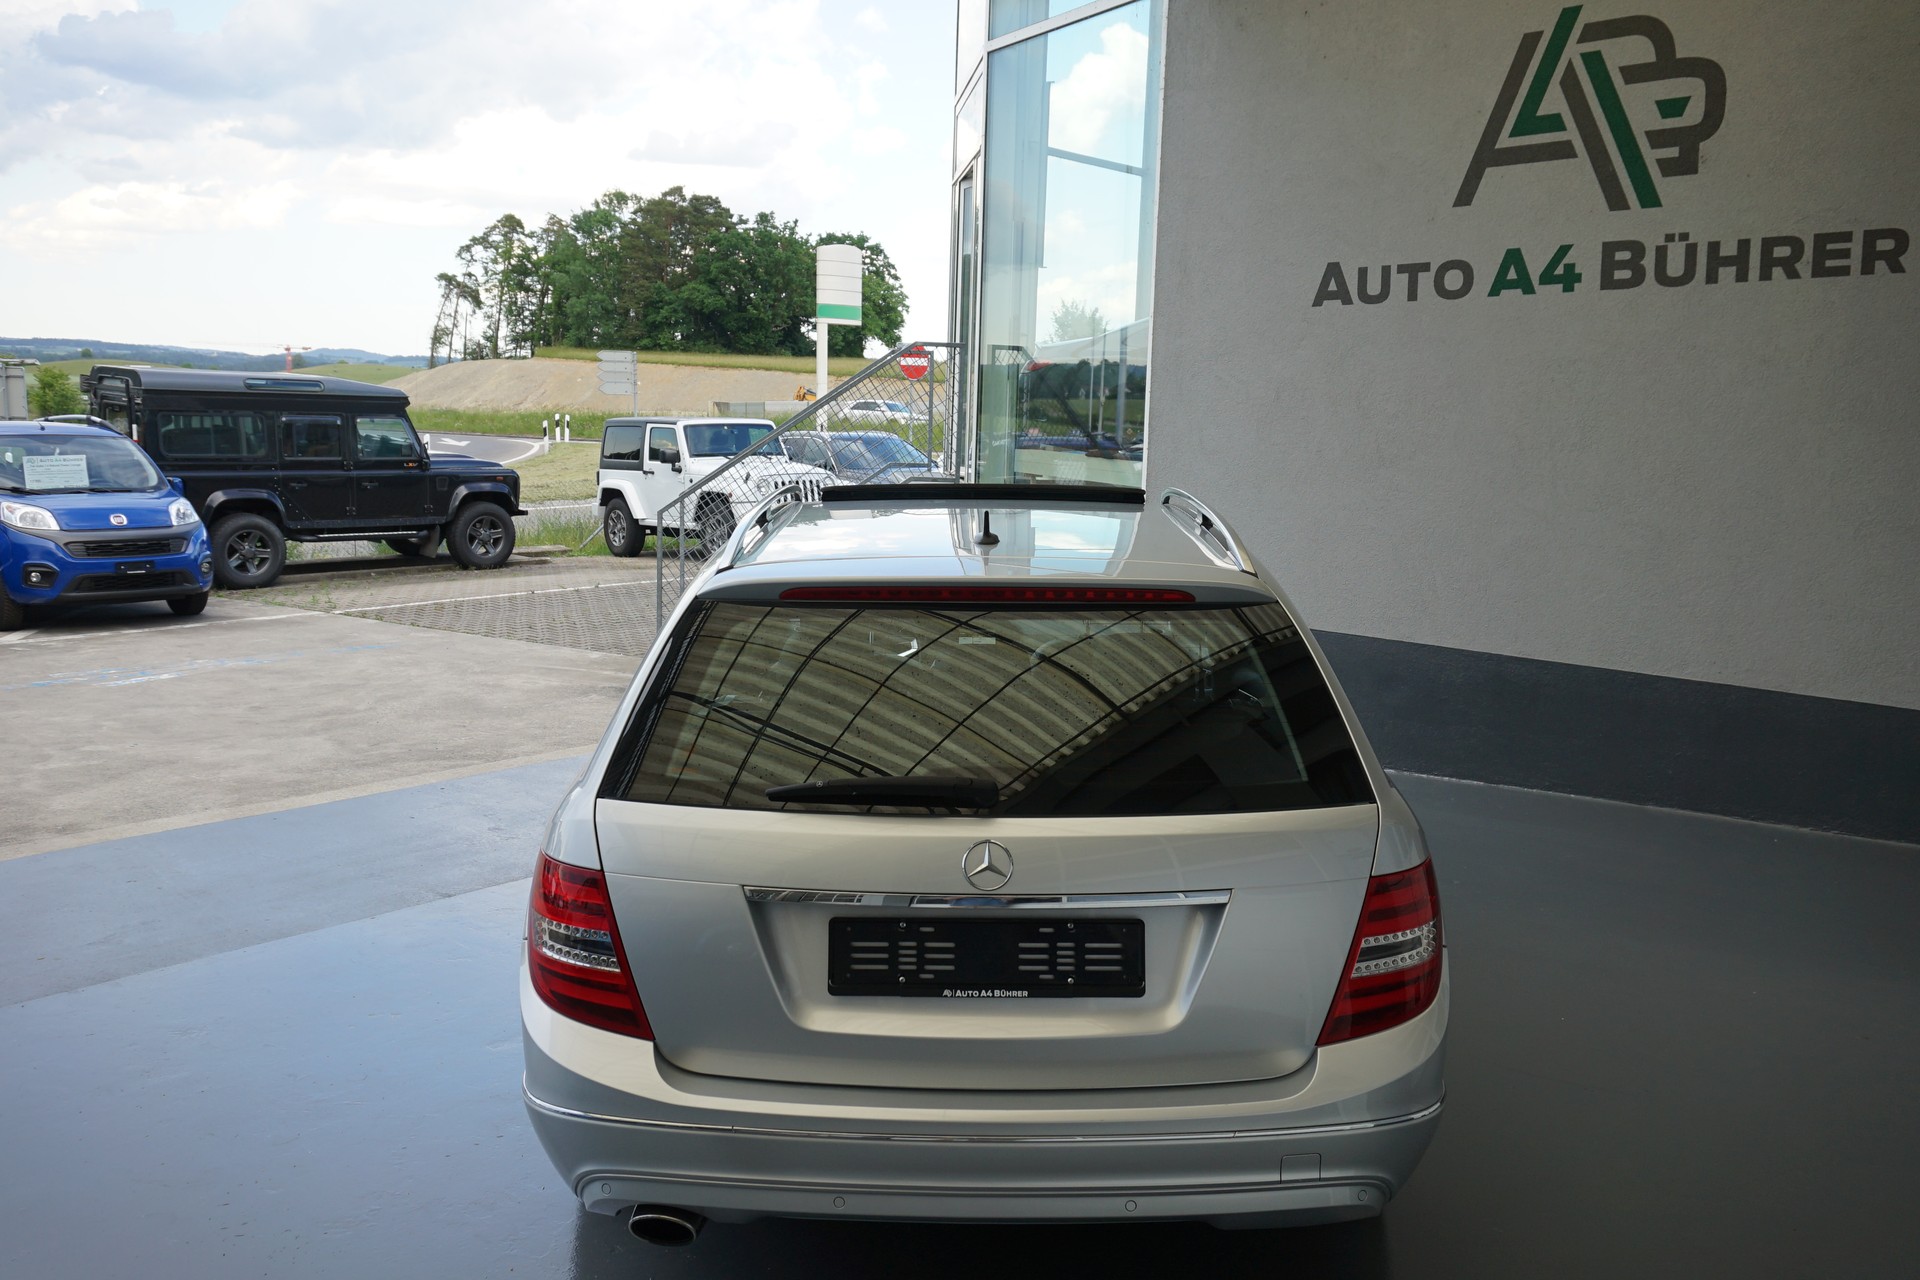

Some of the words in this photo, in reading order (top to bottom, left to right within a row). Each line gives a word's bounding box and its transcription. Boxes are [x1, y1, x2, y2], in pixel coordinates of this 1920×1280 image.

[1312, 259, 1475, 307] AUTO
[1487, 244, 1583, 297] A4
[1600, 227, 1910, 291] BÜHRER
[955, 989, 979, 997] AUTO
[980, 989, 993, 997] A4
[994, 989, 1028, 997] BÜHRER
